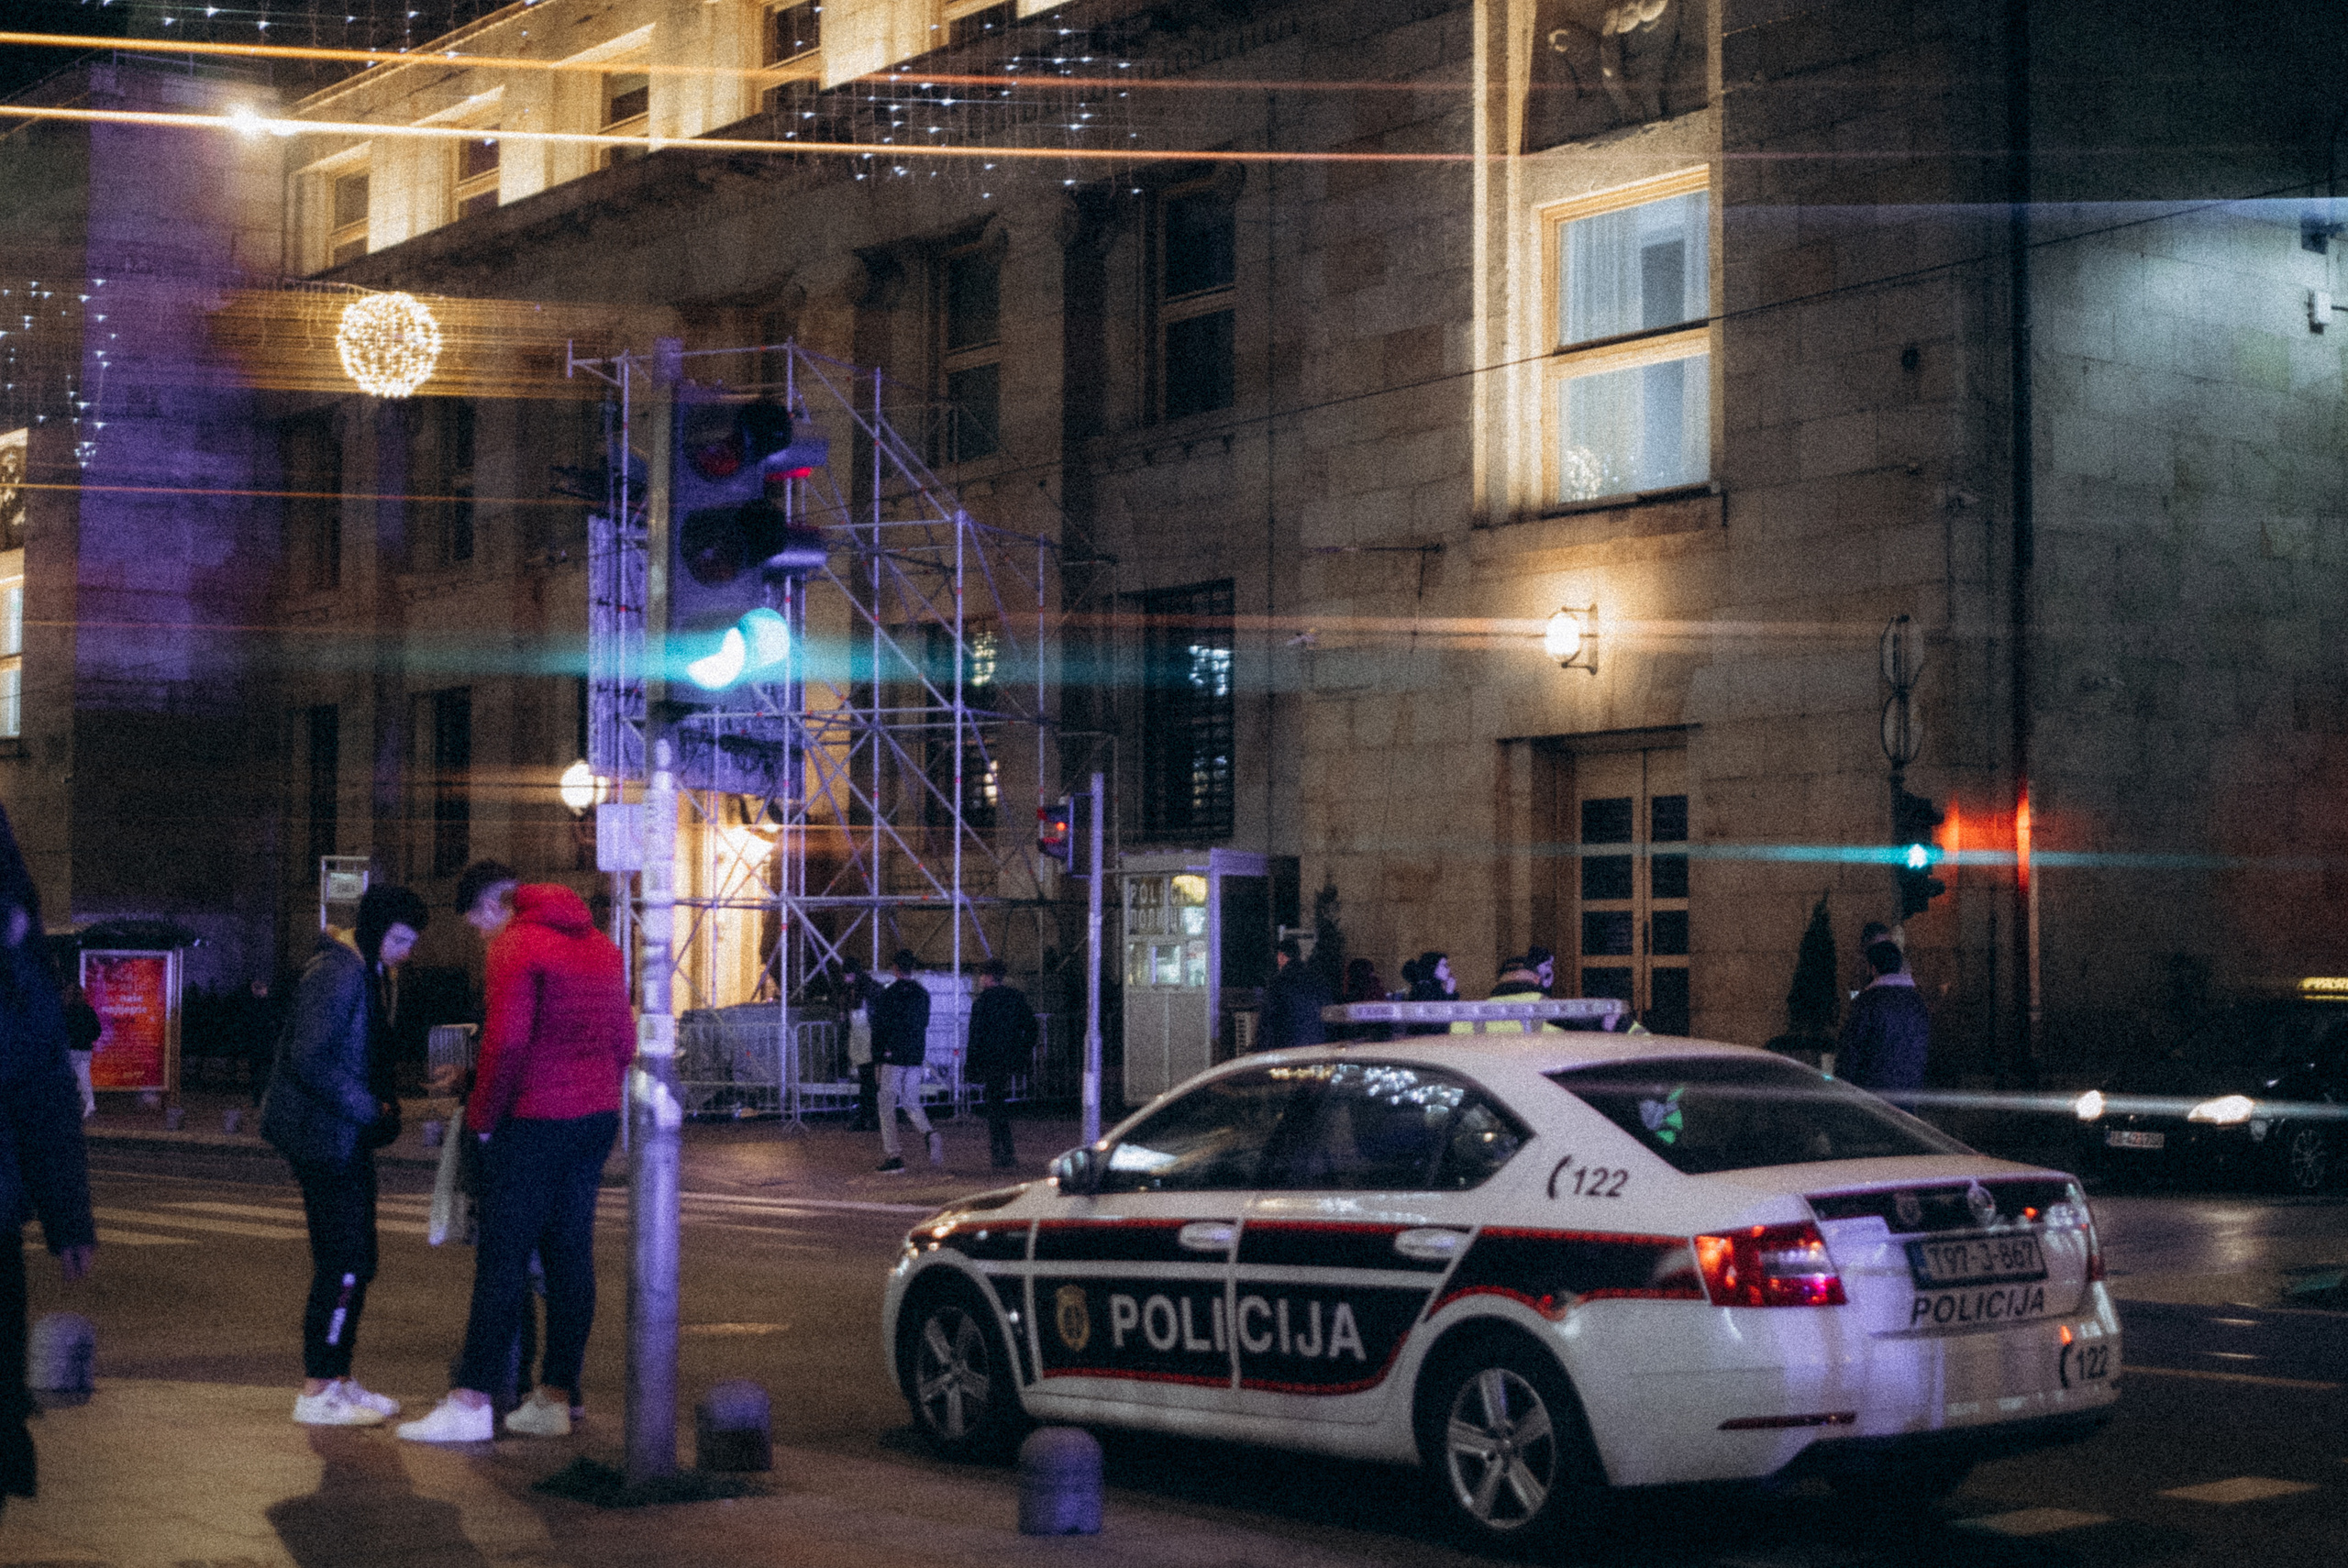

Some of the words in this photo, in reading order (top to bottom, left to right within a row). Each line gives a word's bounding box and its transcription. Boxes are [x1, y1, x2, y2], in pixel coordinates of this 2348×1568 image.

[1574, 1165, 1629, 1198] 122
[1911, 1286, 2045, 1324] POLICIJA
[1110, 1294, 1367, 1362] POLICIJA
[2077, 1344, 2109, 1380] 122
